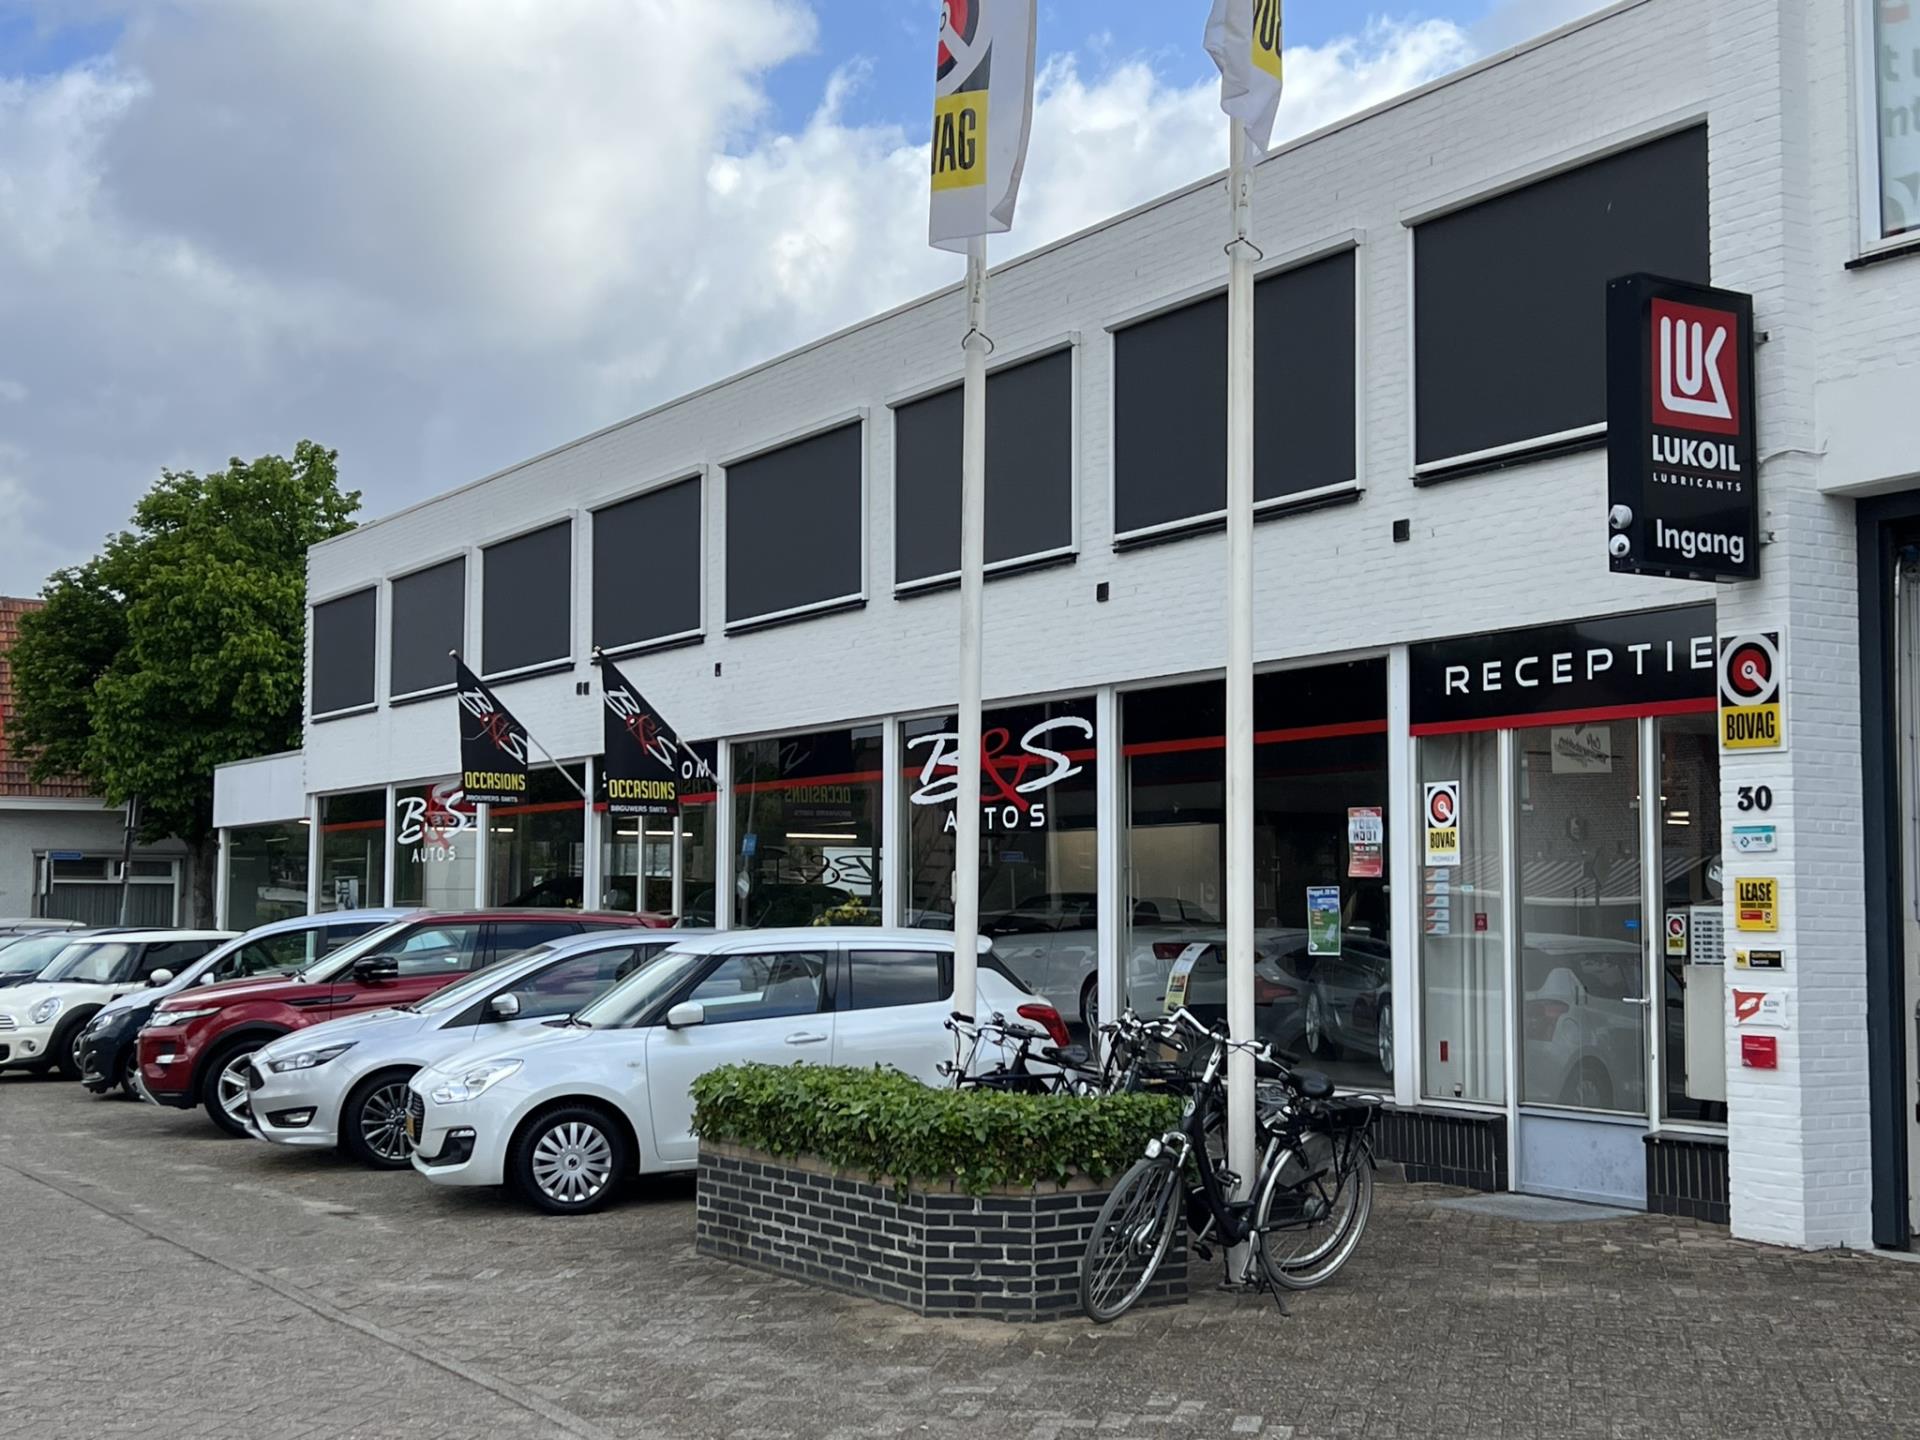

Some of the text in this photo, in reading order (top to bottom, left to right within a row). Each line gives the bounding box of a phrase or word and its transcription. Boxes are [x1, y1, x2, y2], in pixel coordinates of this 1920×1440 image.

[1652, 434, 1741, 471] LUKOIL
[1653, 472, 1742, 492] LUBRICANTS
[1656, 519, 1744, 563] Ingang
[1446, 636, 1713, 695] RECEPTIE
[1726, 710, 1775, 741] BOVAG
[907, 716, 1093, 812] B&S
[464, 771, 526, 791] OCCASIONS
[609, 779, 676, 800] OCCASIONS
[1737, 785, 1773, 811] 30
[943, 803, 1045, 833] ATOS
[1430, 831, 1456, 849] BOVAG
[411, 845, 456, 863] AUTOS
[1740, 882, 1773, 901] LEASE
